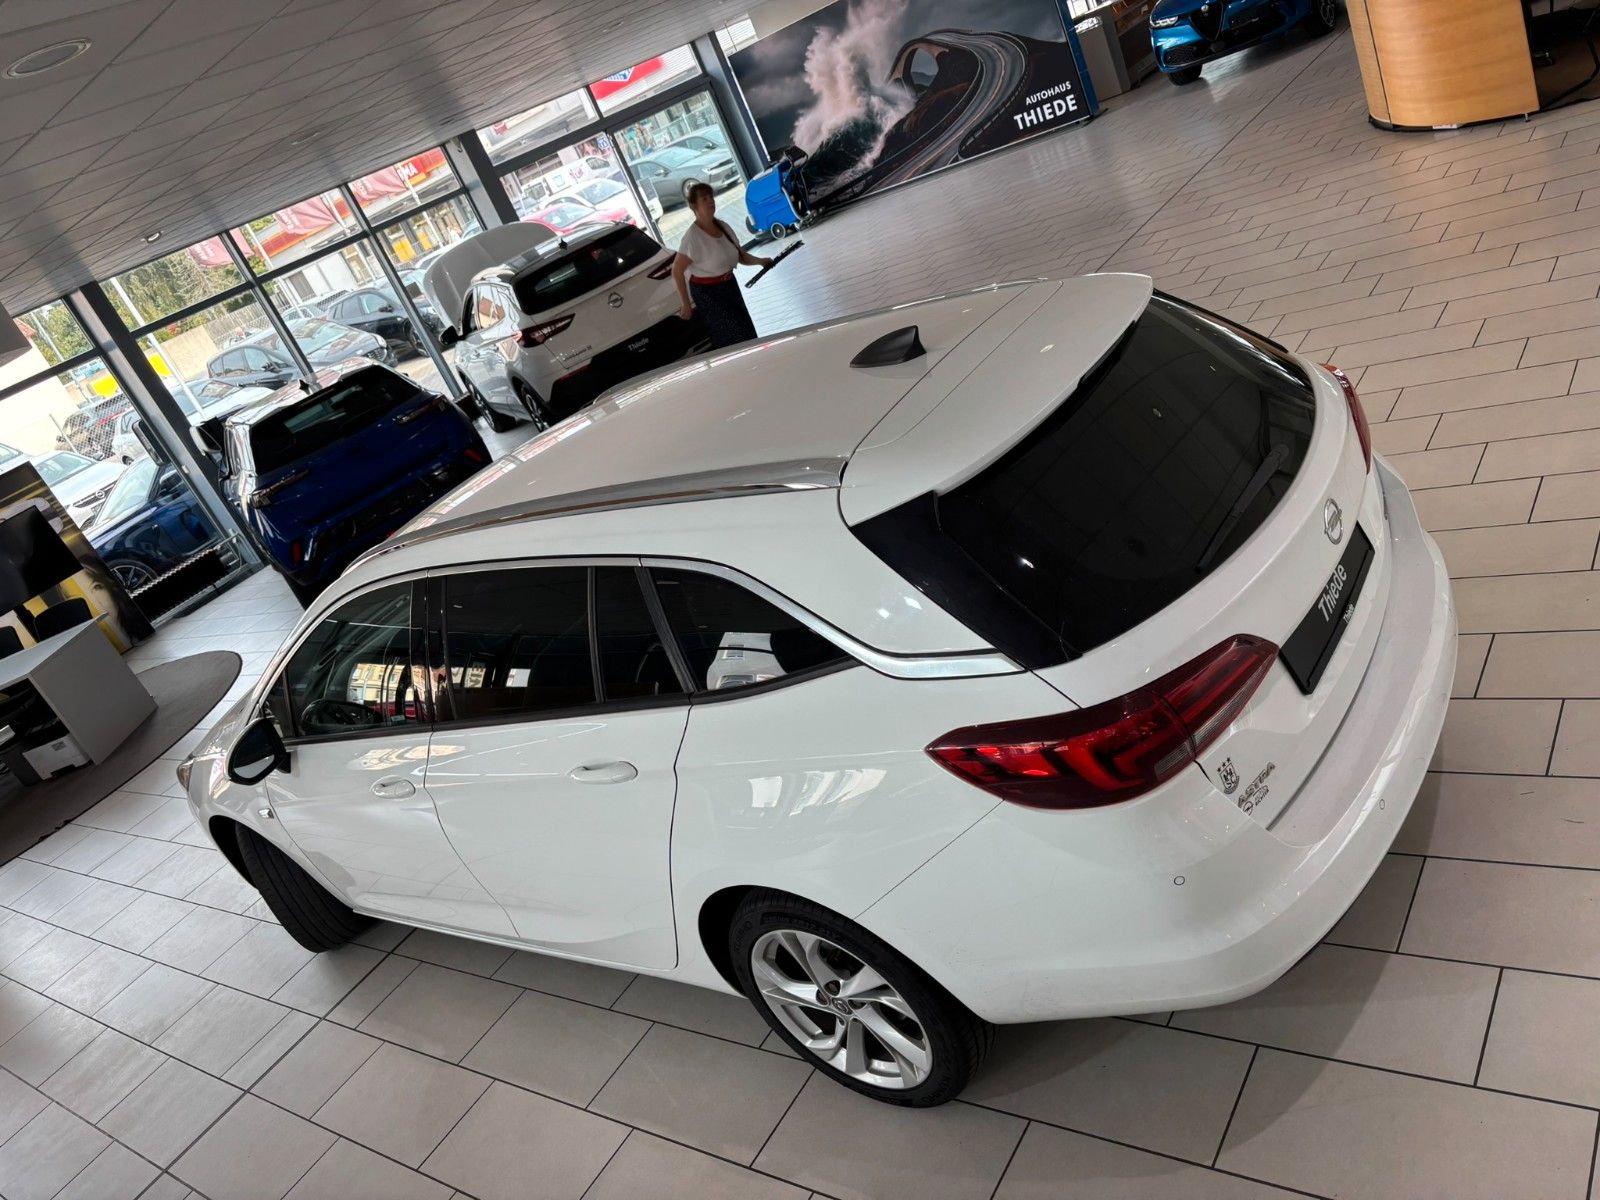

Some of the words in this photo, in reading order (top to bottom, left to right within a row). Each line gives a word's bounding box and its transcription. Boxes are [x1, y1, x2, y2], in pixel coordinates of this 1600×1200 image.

[1025, 81, 1072, 106] AUTOHAUS
[1013, 94, 1078, 130] THIEDE
[628, 337, 649, 351] Thiede
[1317, 563, 1347, 622] Thiede
[1237, 761, 1276, 809] ASTRA
